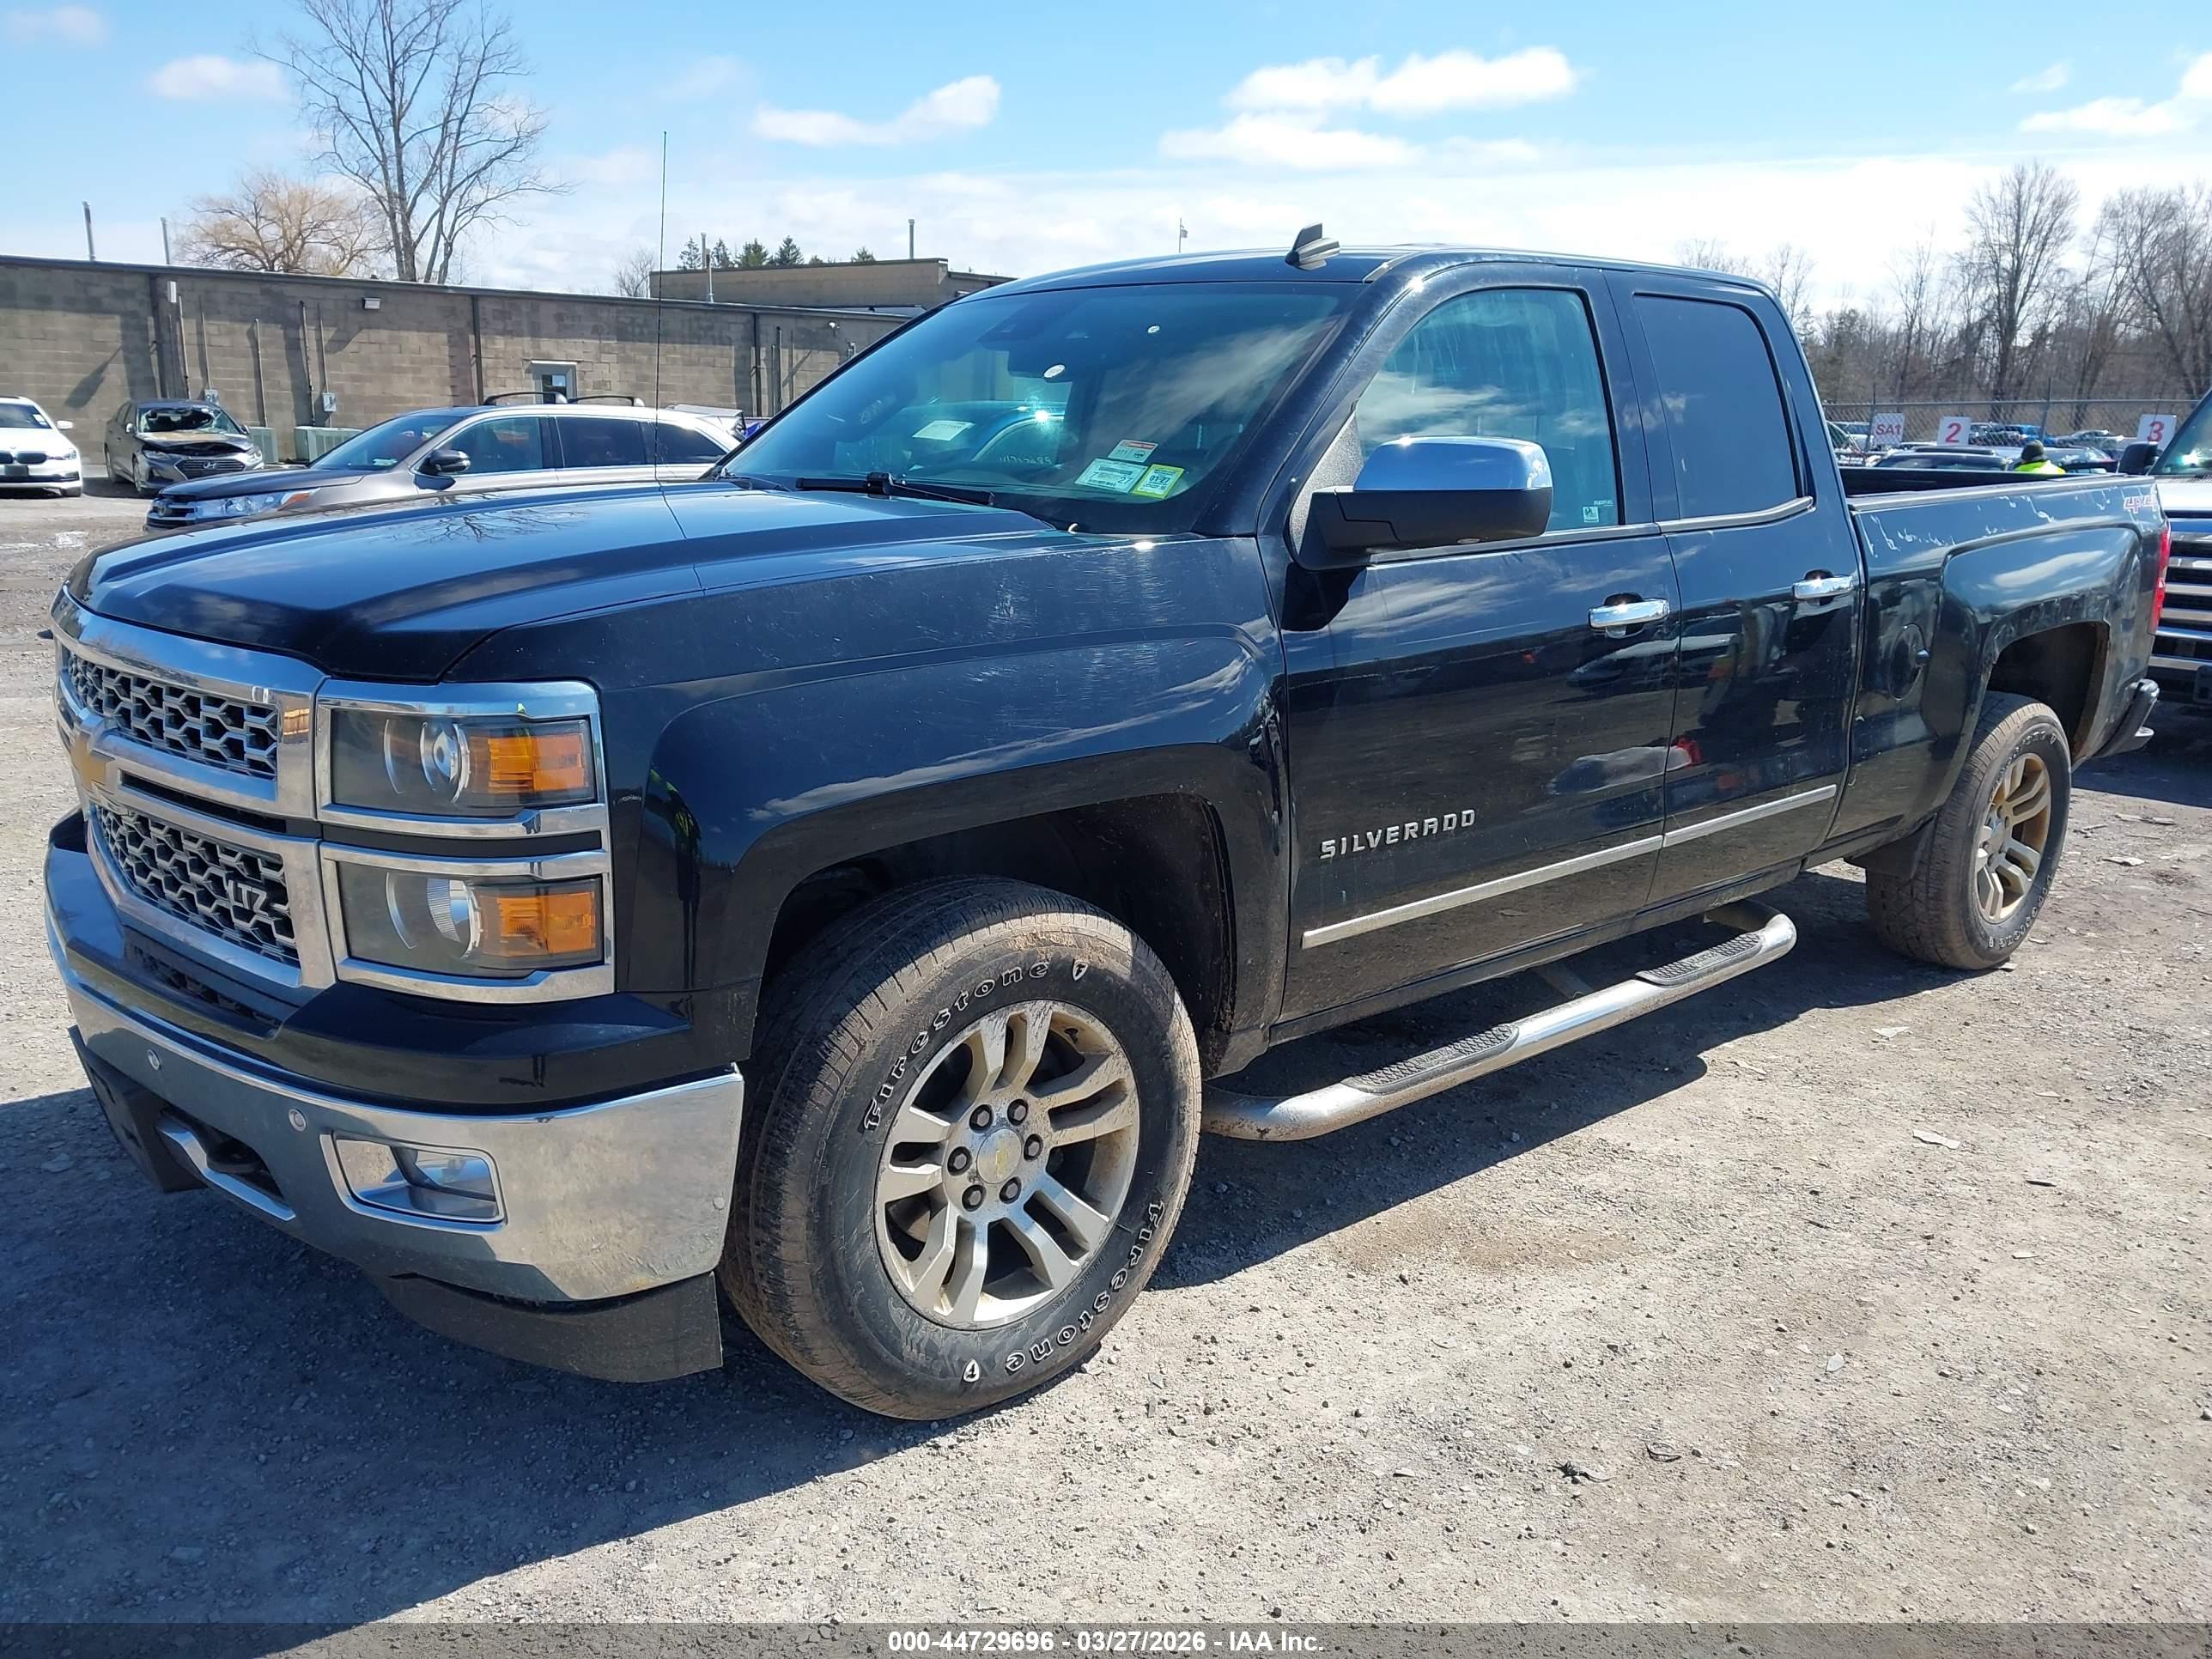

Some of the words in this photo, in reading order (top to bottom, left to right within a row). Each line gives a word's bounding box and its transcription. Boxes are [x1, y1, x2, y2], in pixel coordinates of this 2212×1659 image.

[1945, 422, 1962, 443] 2
[2147, 421, 2165, 442] 3
[1319, 809, 1476, 859] SILVERADO
[228, 879, 269, 916] LTZ
[862, 958, 1051, 1133] Firestone
[1005, 1199, 1165, 1374] Firestone
